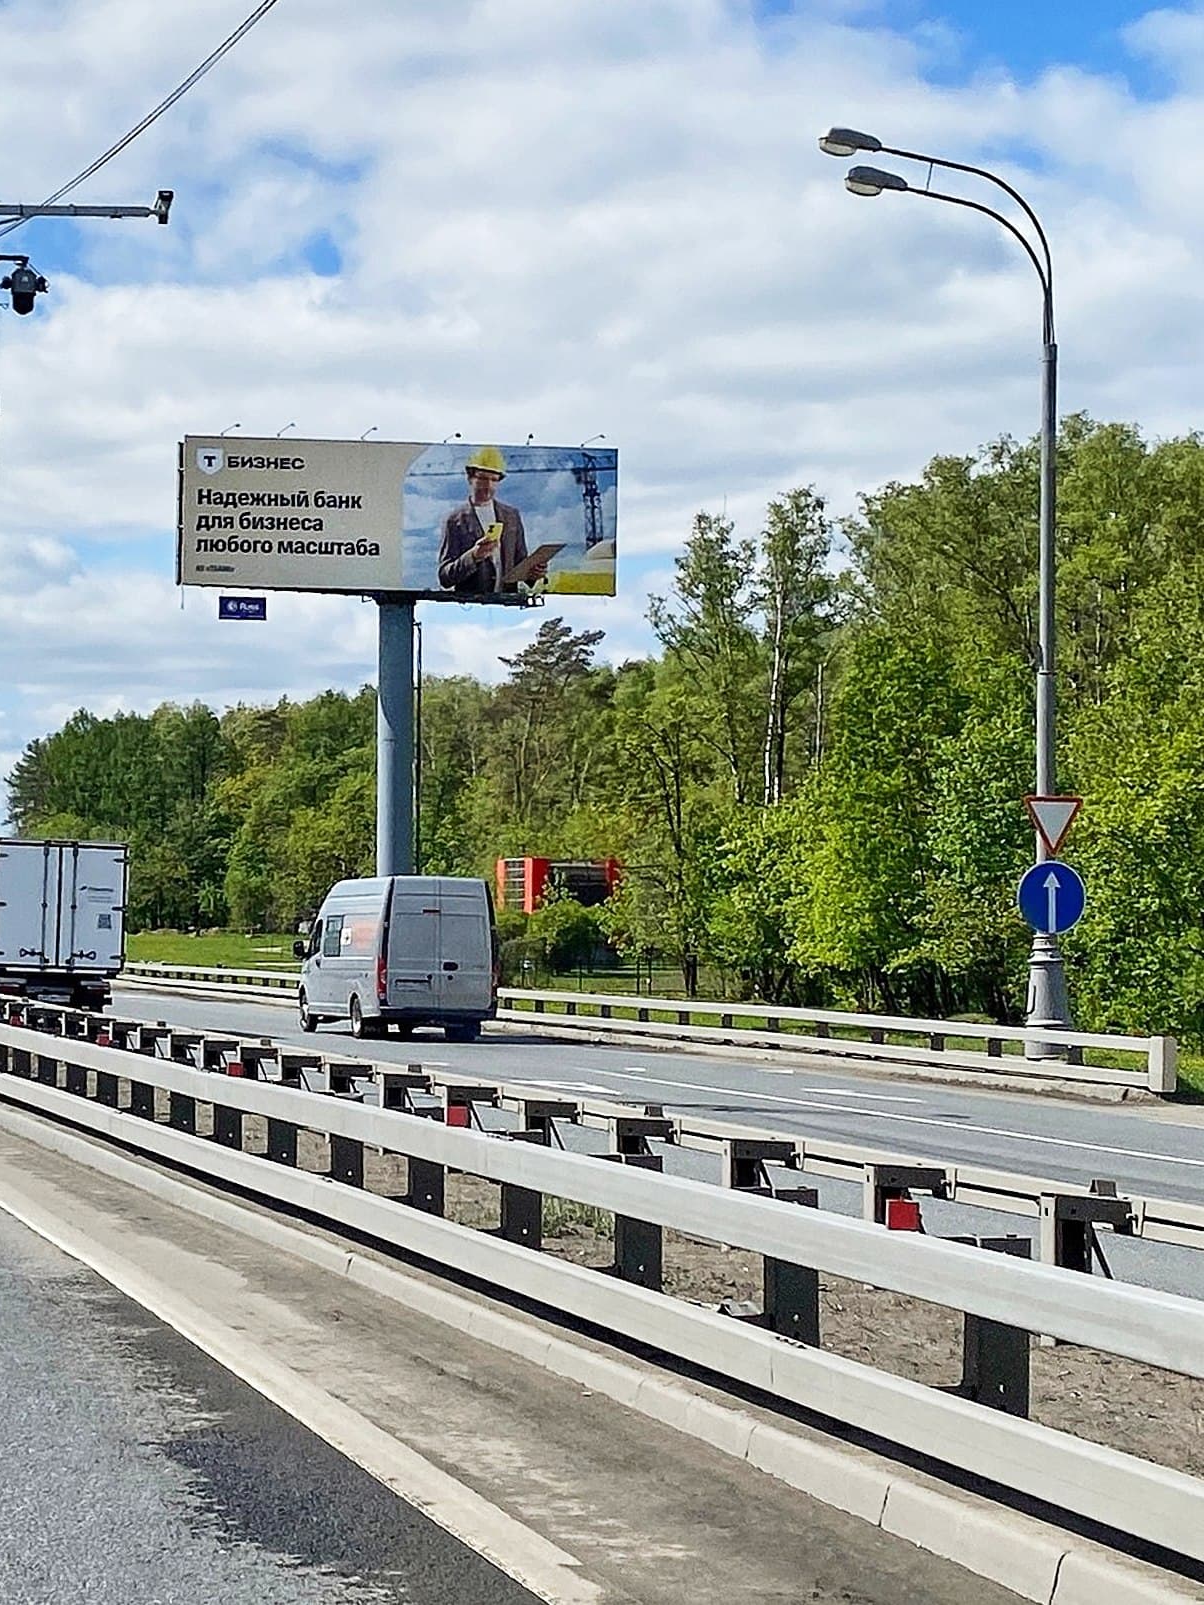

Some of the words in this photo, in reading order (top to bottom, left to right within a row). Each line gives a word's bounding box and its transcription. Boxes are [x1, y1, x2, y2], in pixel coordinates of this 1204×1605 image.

[227, 455, 305, 470] БИЗНЕС
[197, 488, 309, 508] Надежный
[313, 491, 362, 509] банк
[196, 515, 234, 531] для
[239, 511, 323, 531] бизнеса
[196, 535, 273, 554] любого
[277, 538, 380, 556] масштаба
